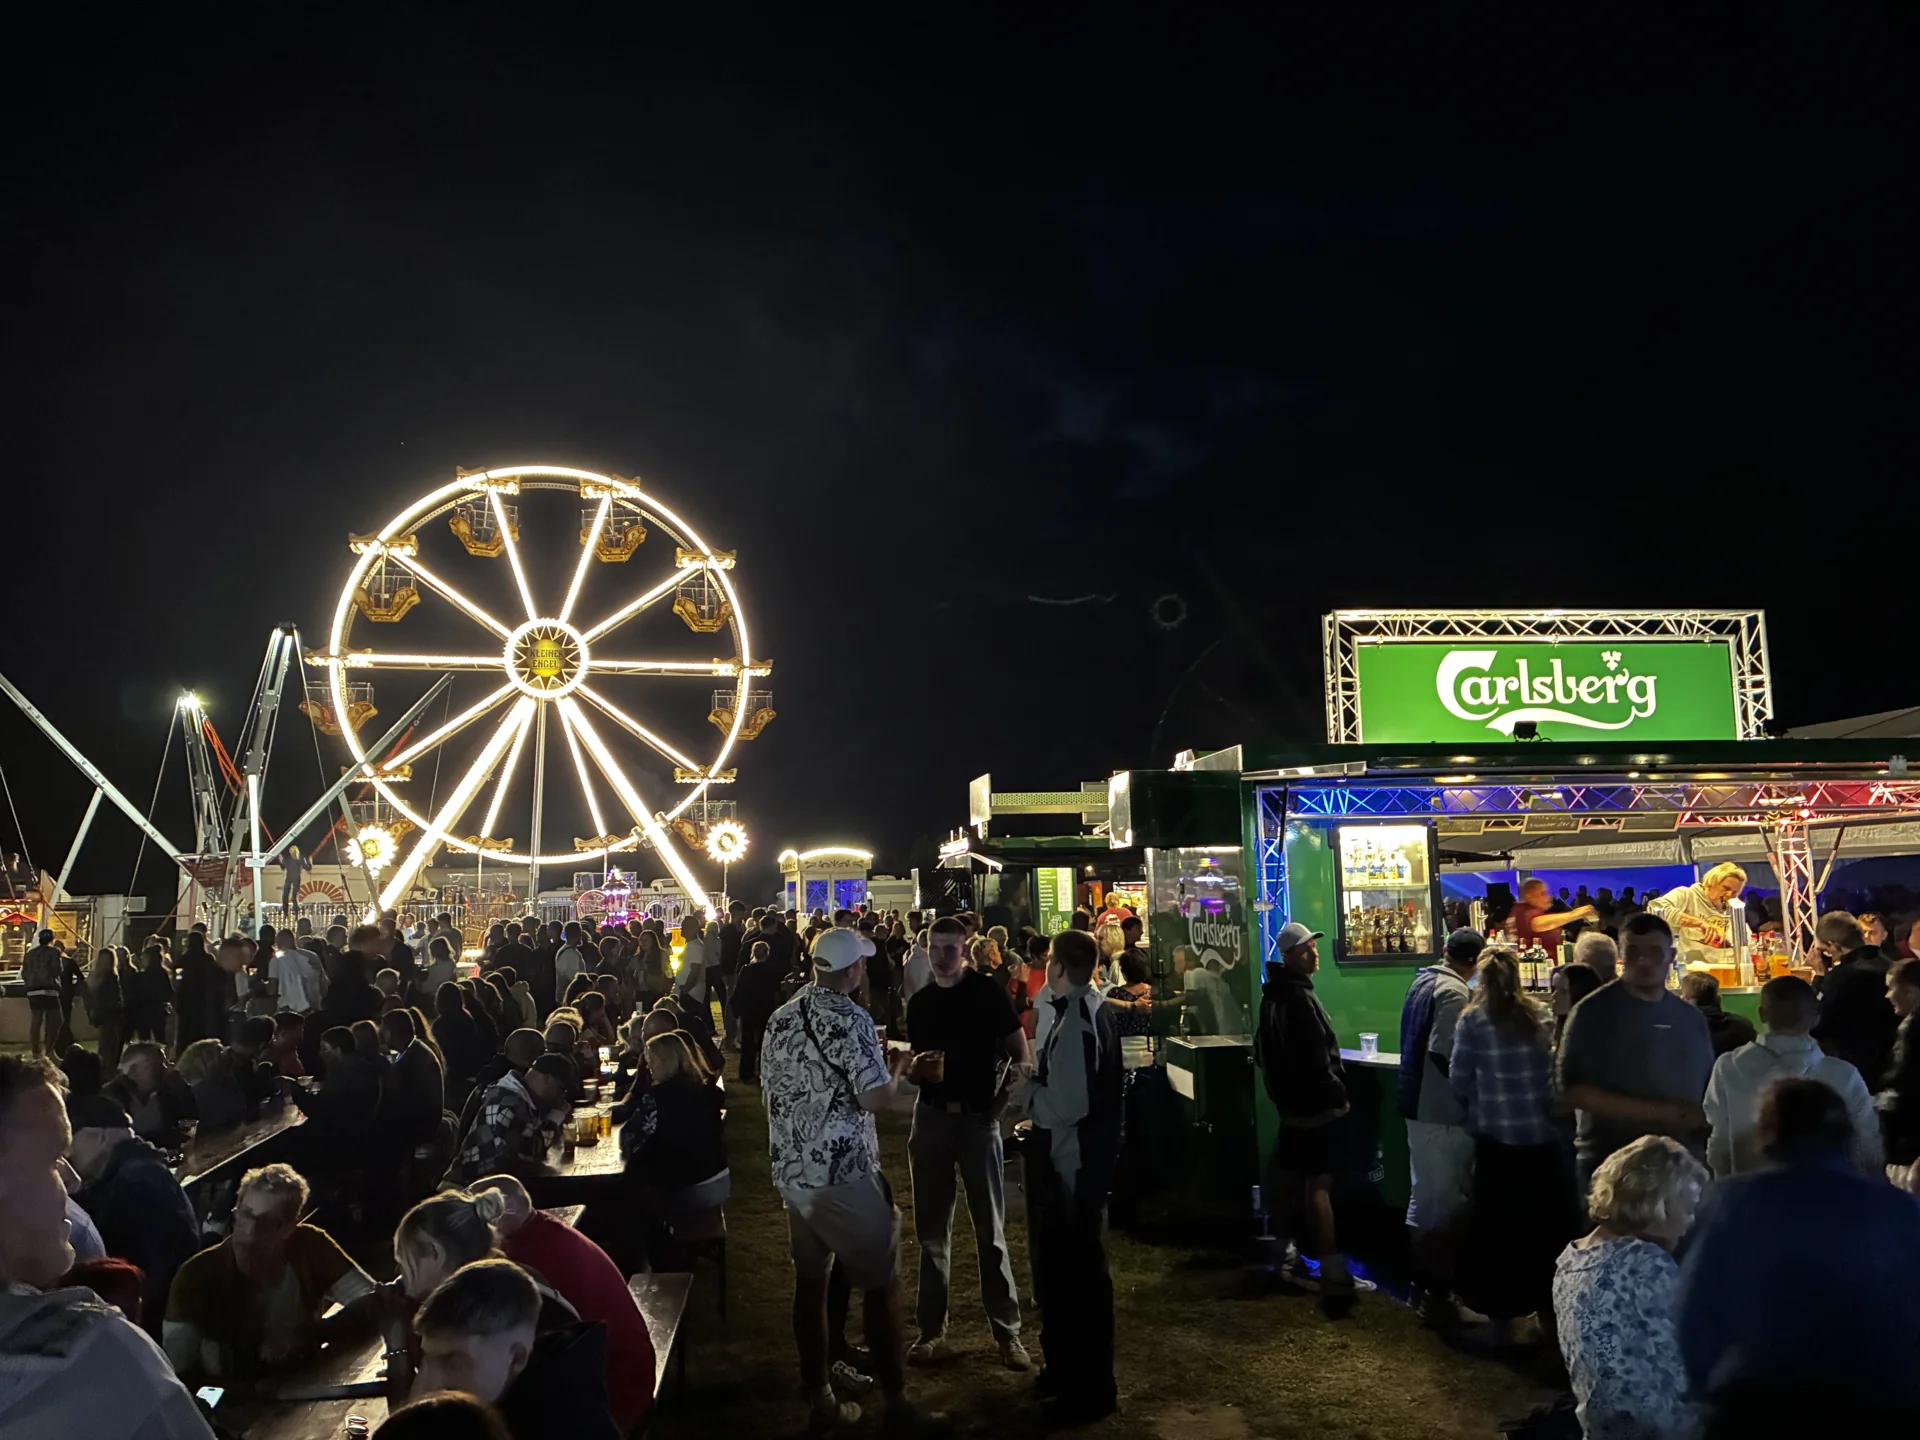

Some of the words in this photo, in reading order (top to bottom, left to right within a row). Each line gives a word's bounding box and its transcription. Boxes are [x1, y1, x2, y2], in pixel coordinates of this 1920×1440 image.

[530, 649, 563, 658] KLEINER
[533, 660, 559, 668] ENGEL
[1436, 650, 1657, 721] Carlsberg
[1188, 901, 1241, 961] Carlsberg
